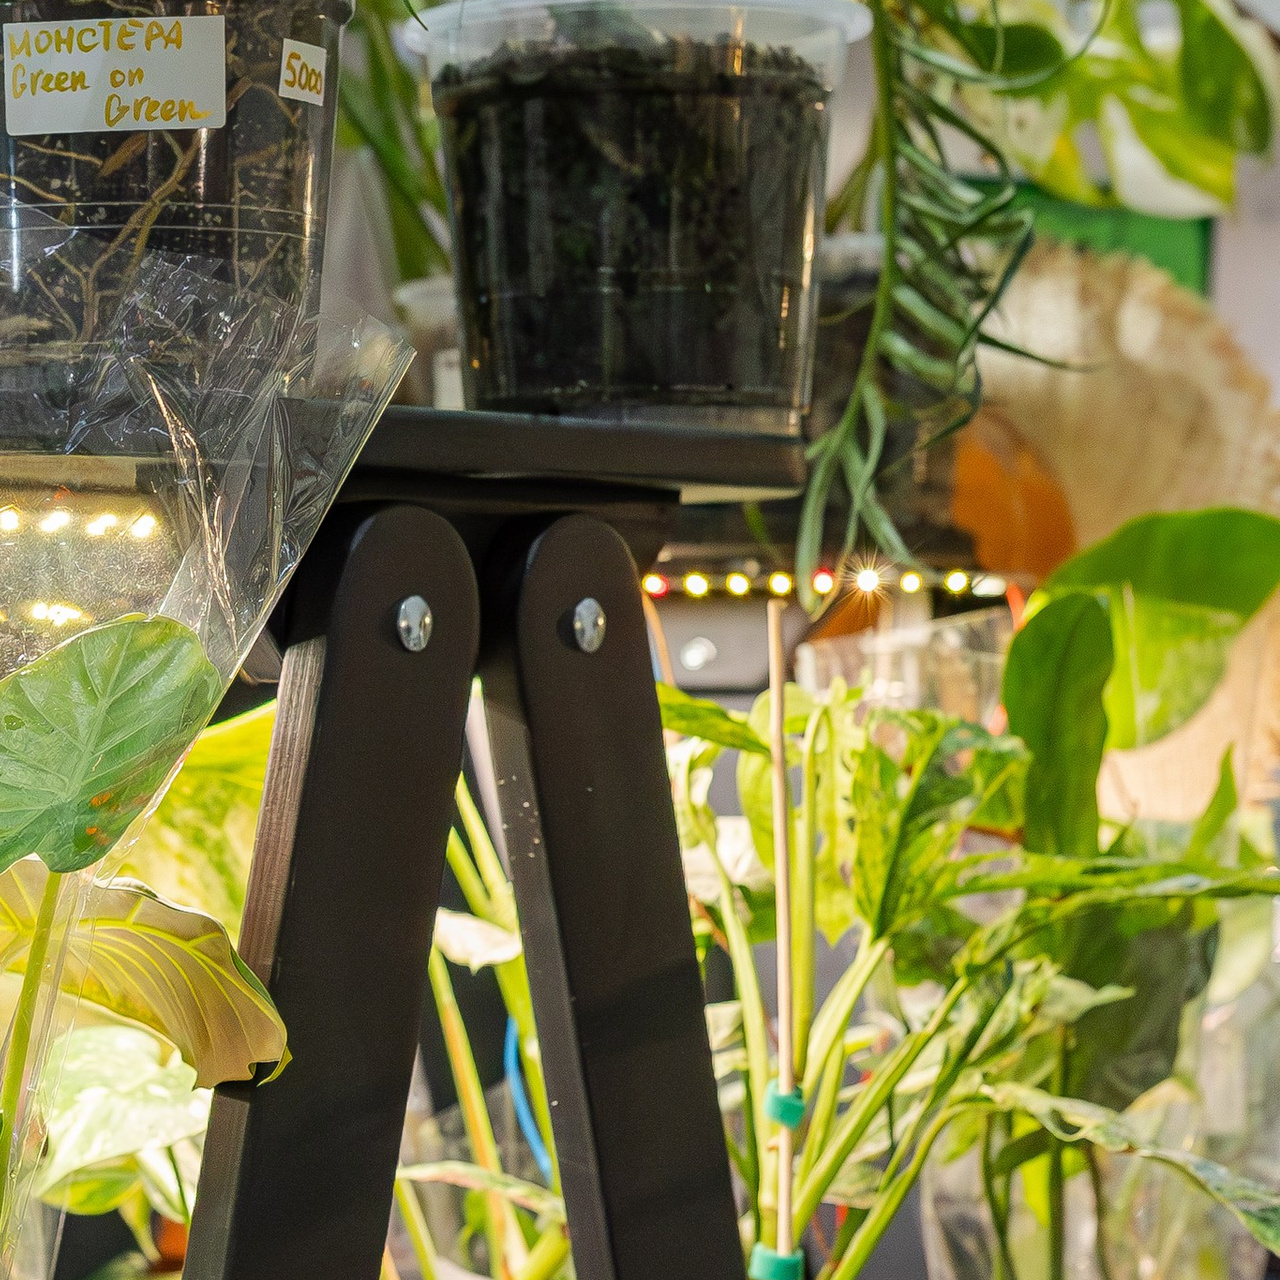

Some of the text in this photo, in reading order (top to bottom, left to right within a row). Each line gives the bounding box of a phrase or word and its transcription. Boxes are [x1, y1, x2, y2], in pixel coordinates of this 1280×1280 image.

[10, 63, 145, 100] Green on
[284, 51, 323, 96] 5000
[104, 92, 212, 128] Green
